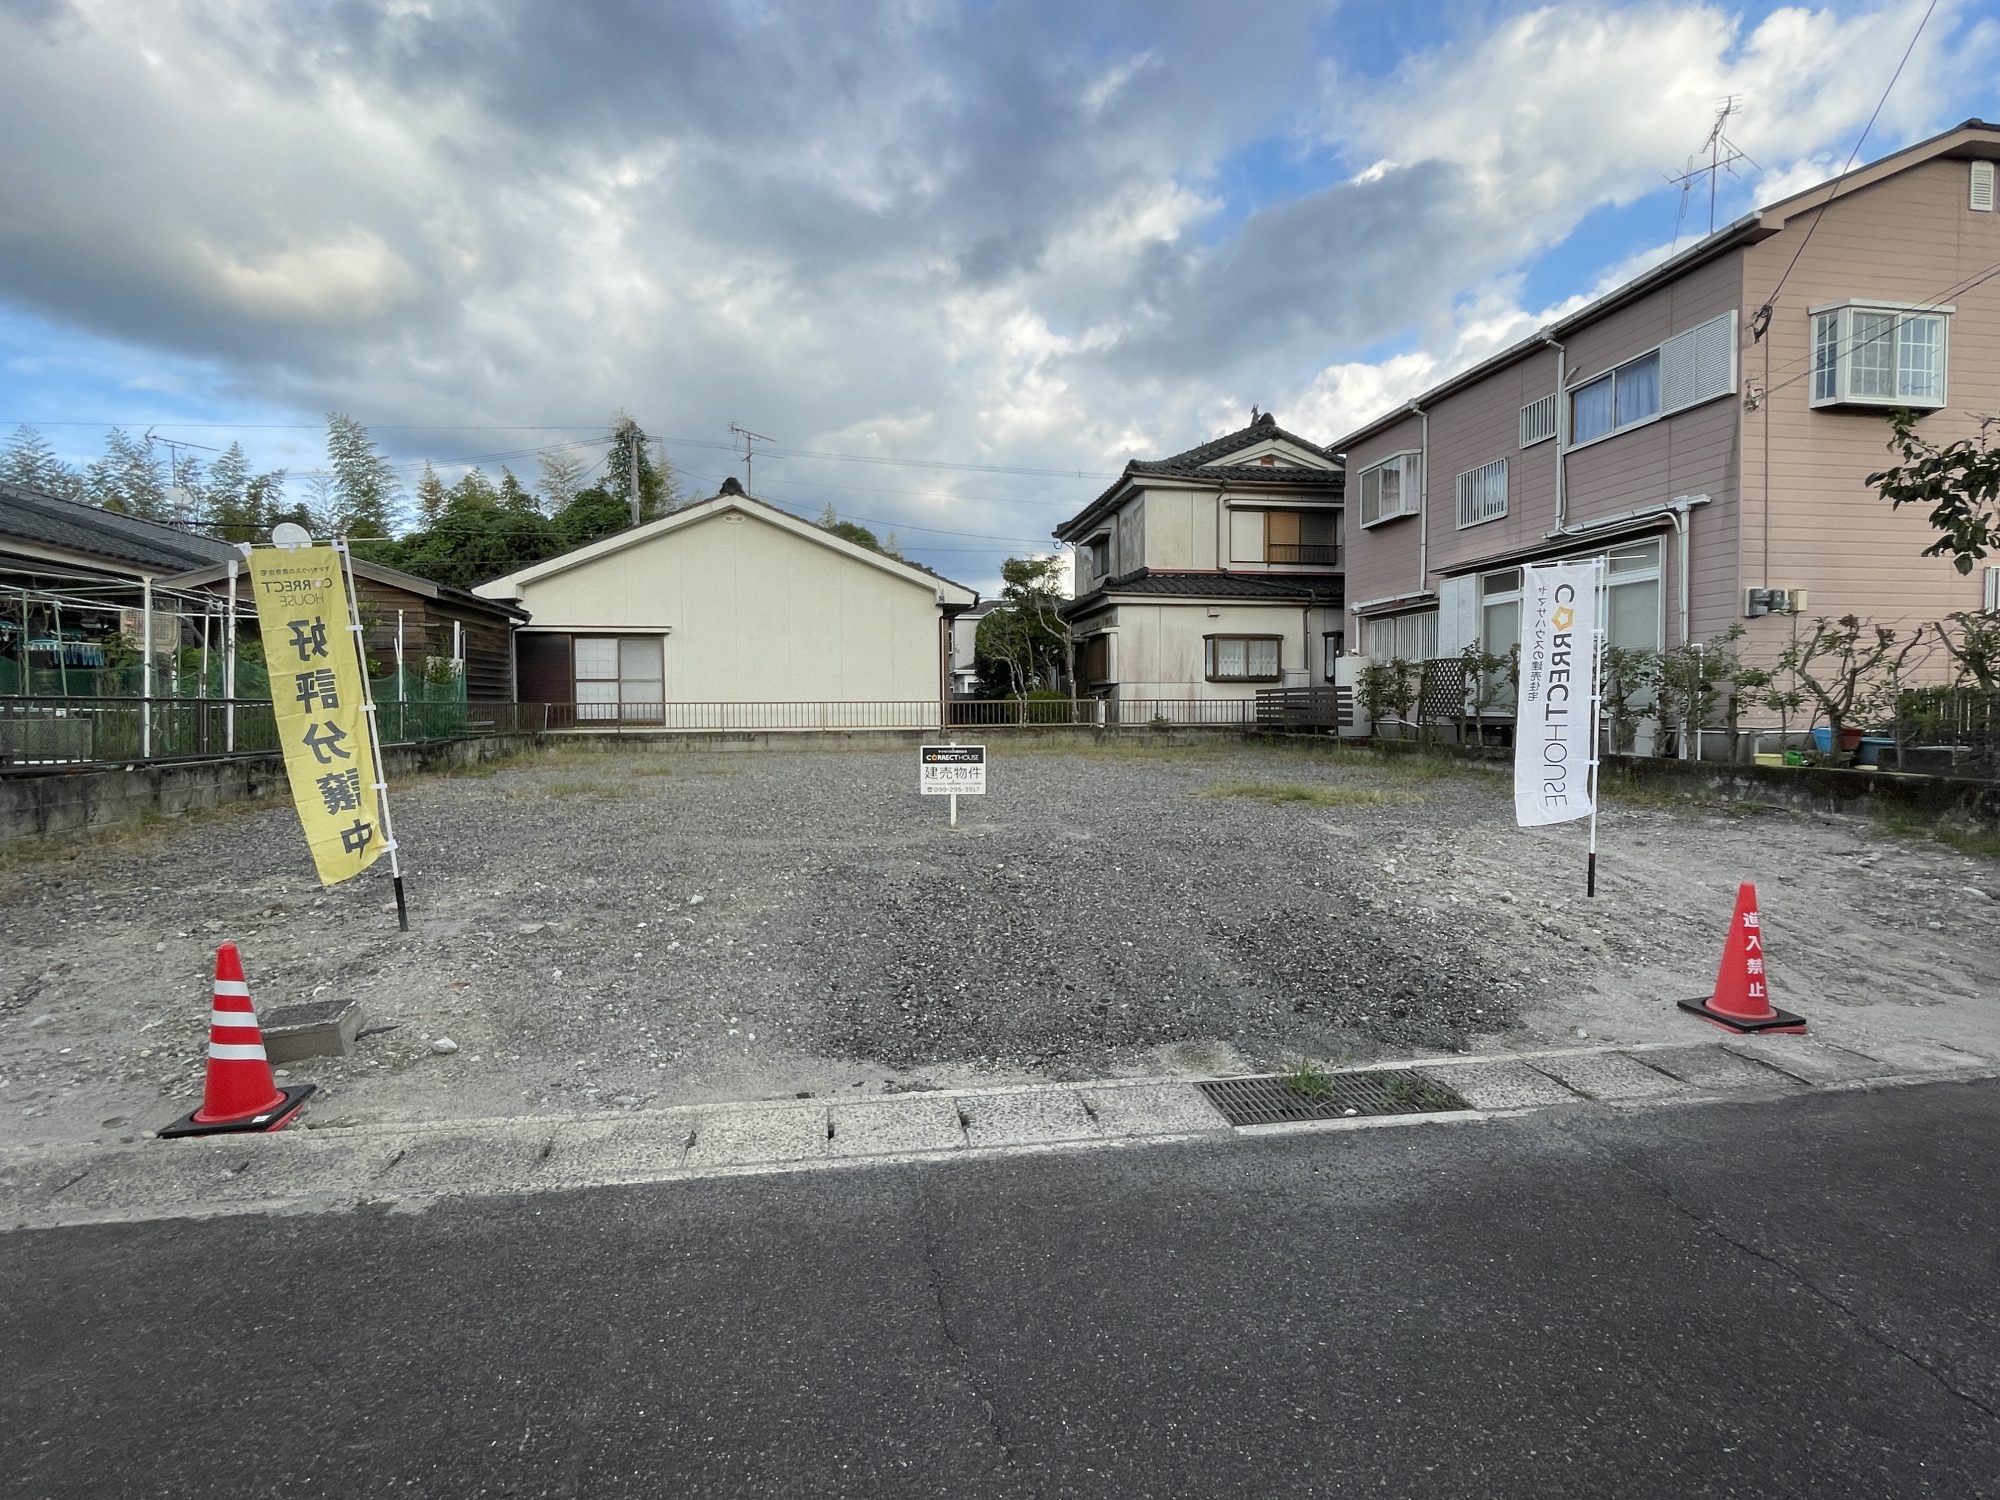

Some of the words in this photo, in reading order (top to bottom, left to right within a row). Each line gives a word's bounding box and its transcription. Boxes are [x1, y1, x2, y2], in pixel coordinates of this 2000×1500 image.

[924, 766, 982, 780] 建売物件
[1743, 912, 1765, 997] 進入禁止
